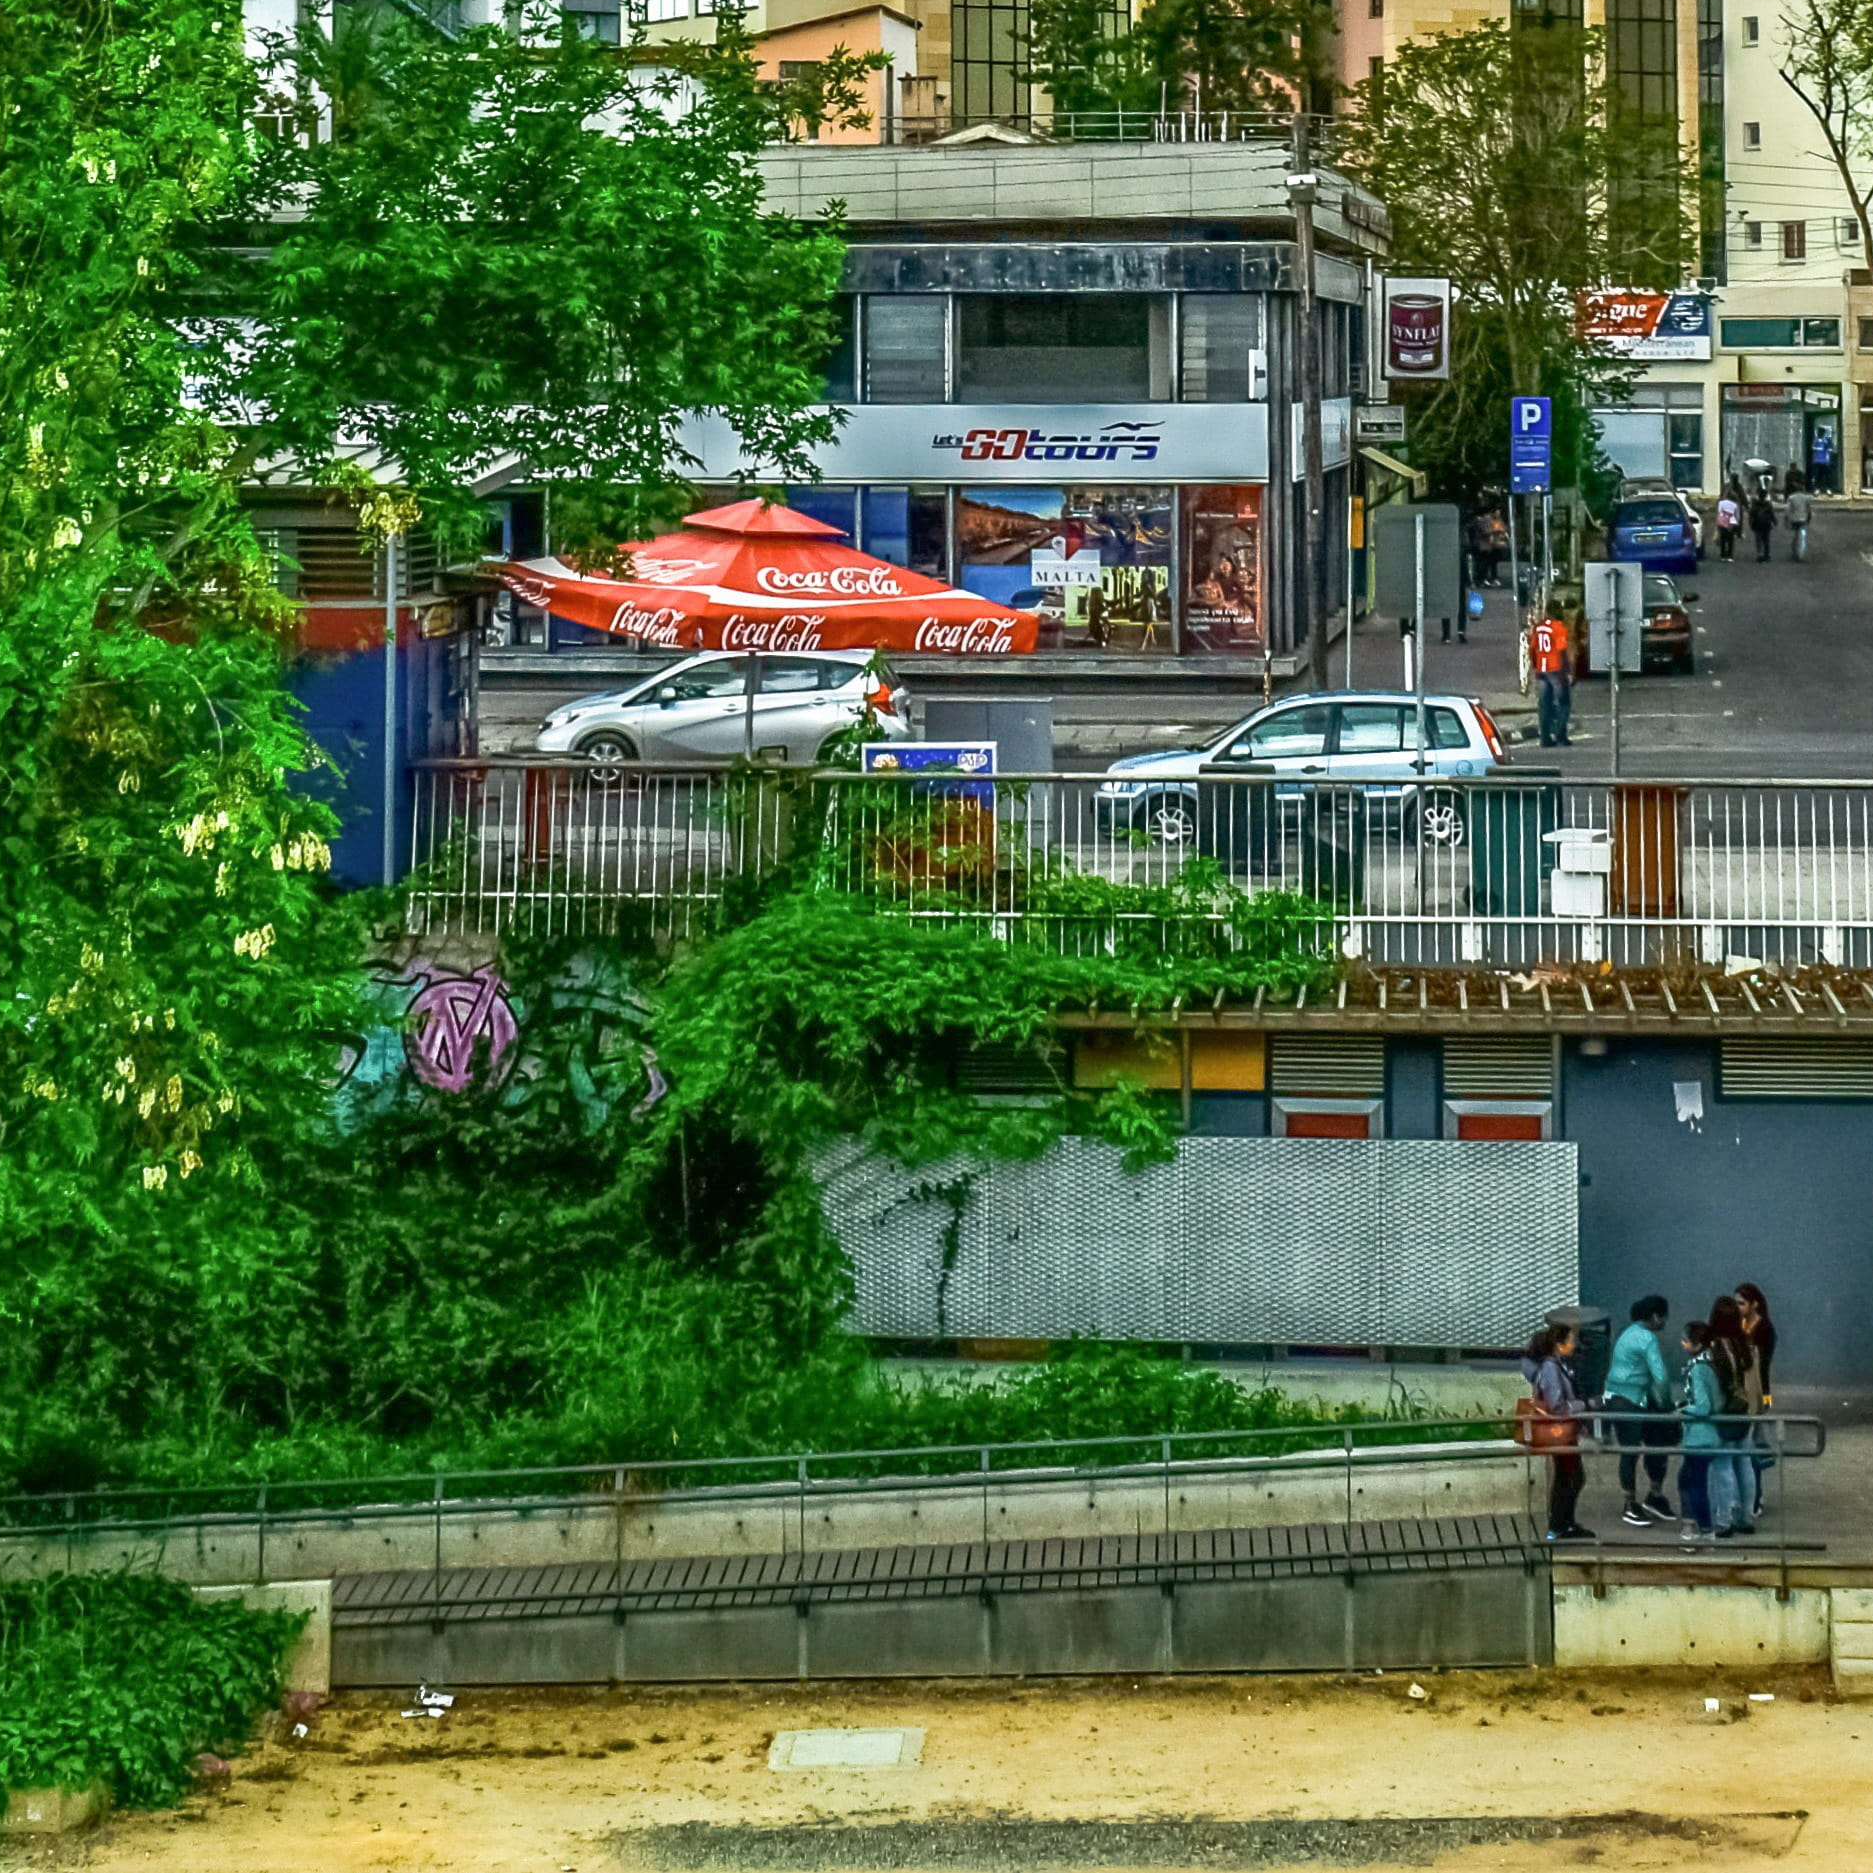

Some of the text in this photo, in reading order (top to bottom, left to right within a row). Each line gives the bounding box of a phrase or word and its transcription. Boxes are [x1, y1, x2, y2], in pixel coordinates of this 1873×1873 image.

[1521, 403, 1542, 431] P
[756, 566, 902, 596] Coca-Cola
[1035, 571, 1096, 583] MALTA
[721, 614, 826, 652] Coca-Cola
[914, 616, 1018, 653] Coca-Cola
[1538, 633, 1552, 653] 10
